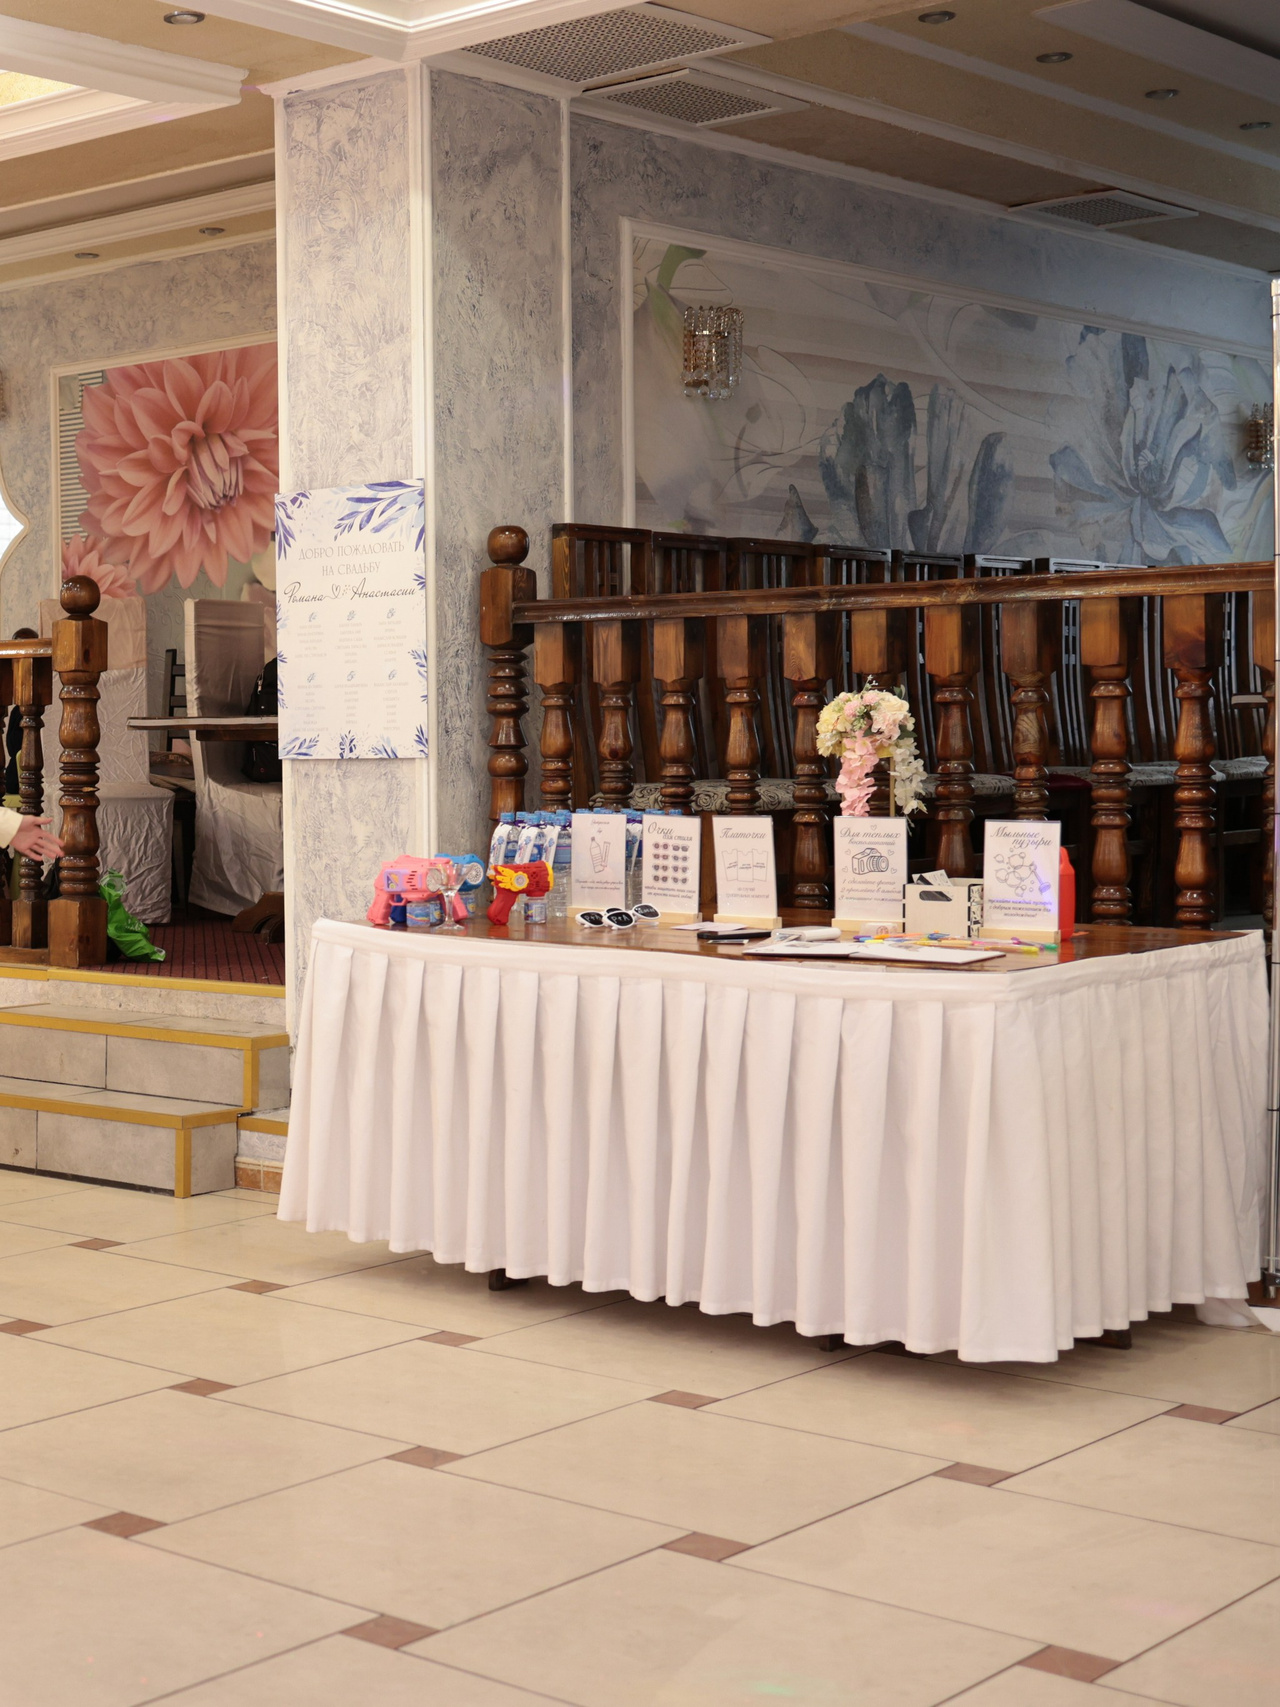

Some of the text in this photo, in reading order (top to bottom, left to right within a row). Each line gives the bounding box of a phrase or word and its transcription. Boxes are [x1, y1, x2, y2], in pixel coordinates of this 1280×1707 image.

[299, 541, 405, 561] ДОБРО ПОЖАЛОВАТЬ
[321, 561, 381, 577] НА СВАДЬБУ
[283, 577, 416, 604] Романа Анастасии
[647, 821, 675, 835] Очки
[719, 827, 767, 839] Платочки
[840, 827, 860, 838] Для
[990, 826, 1040, 838] Мыльные
[1011, 837, 1052, 850] пузыри
